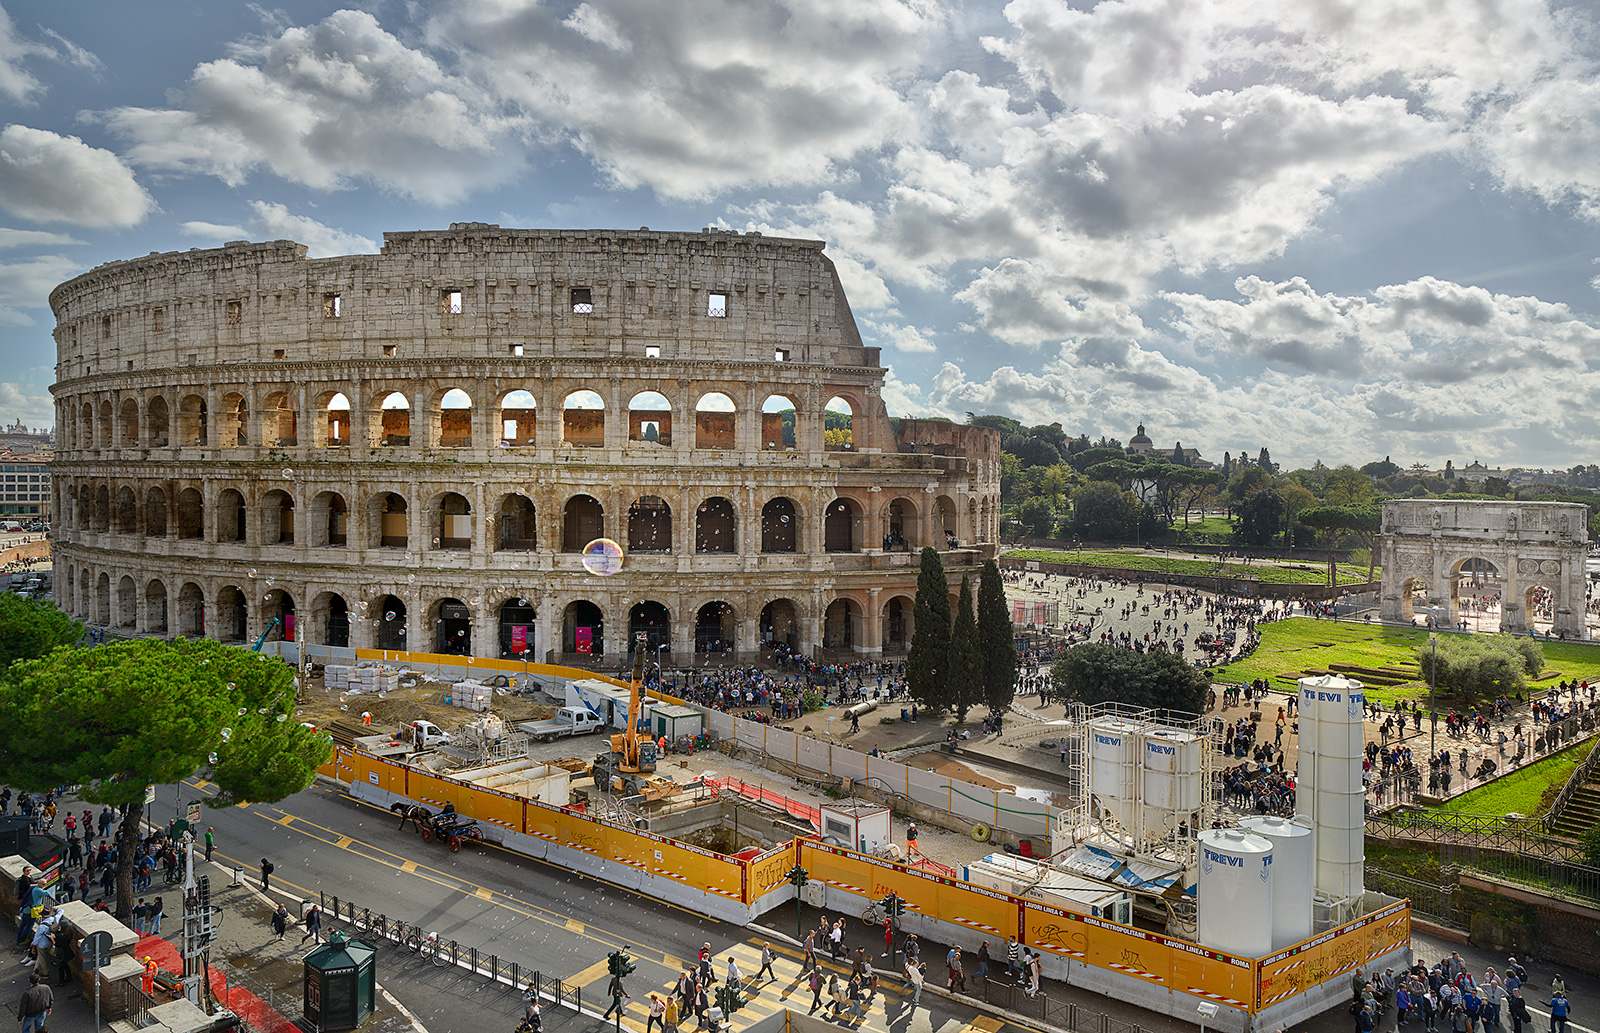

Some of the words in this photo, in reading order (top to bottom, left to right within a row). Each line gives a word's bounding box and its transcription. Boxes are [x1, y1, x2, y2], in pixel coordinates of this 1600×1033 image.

[1094, 734, 1121, 746] TREVI
[1146, 742, 1175, 756] TREVI
[1204, 848, 1243, 868] TREVI
[956, 882, 970, 891] ROMA
[1024, 901, 1042, 911] LAVORI
[1043, 906, 1059, 915] LINEA
[1084, 917, 1100, 926] ROMA
[1101, 922, 1146, 939] METROPOLITANE
[1164, 939, 1185, 950] LAVORI
[1186, 946, 1204, 956] LINEA
[1230, 958, 1250, 969] ROMA
